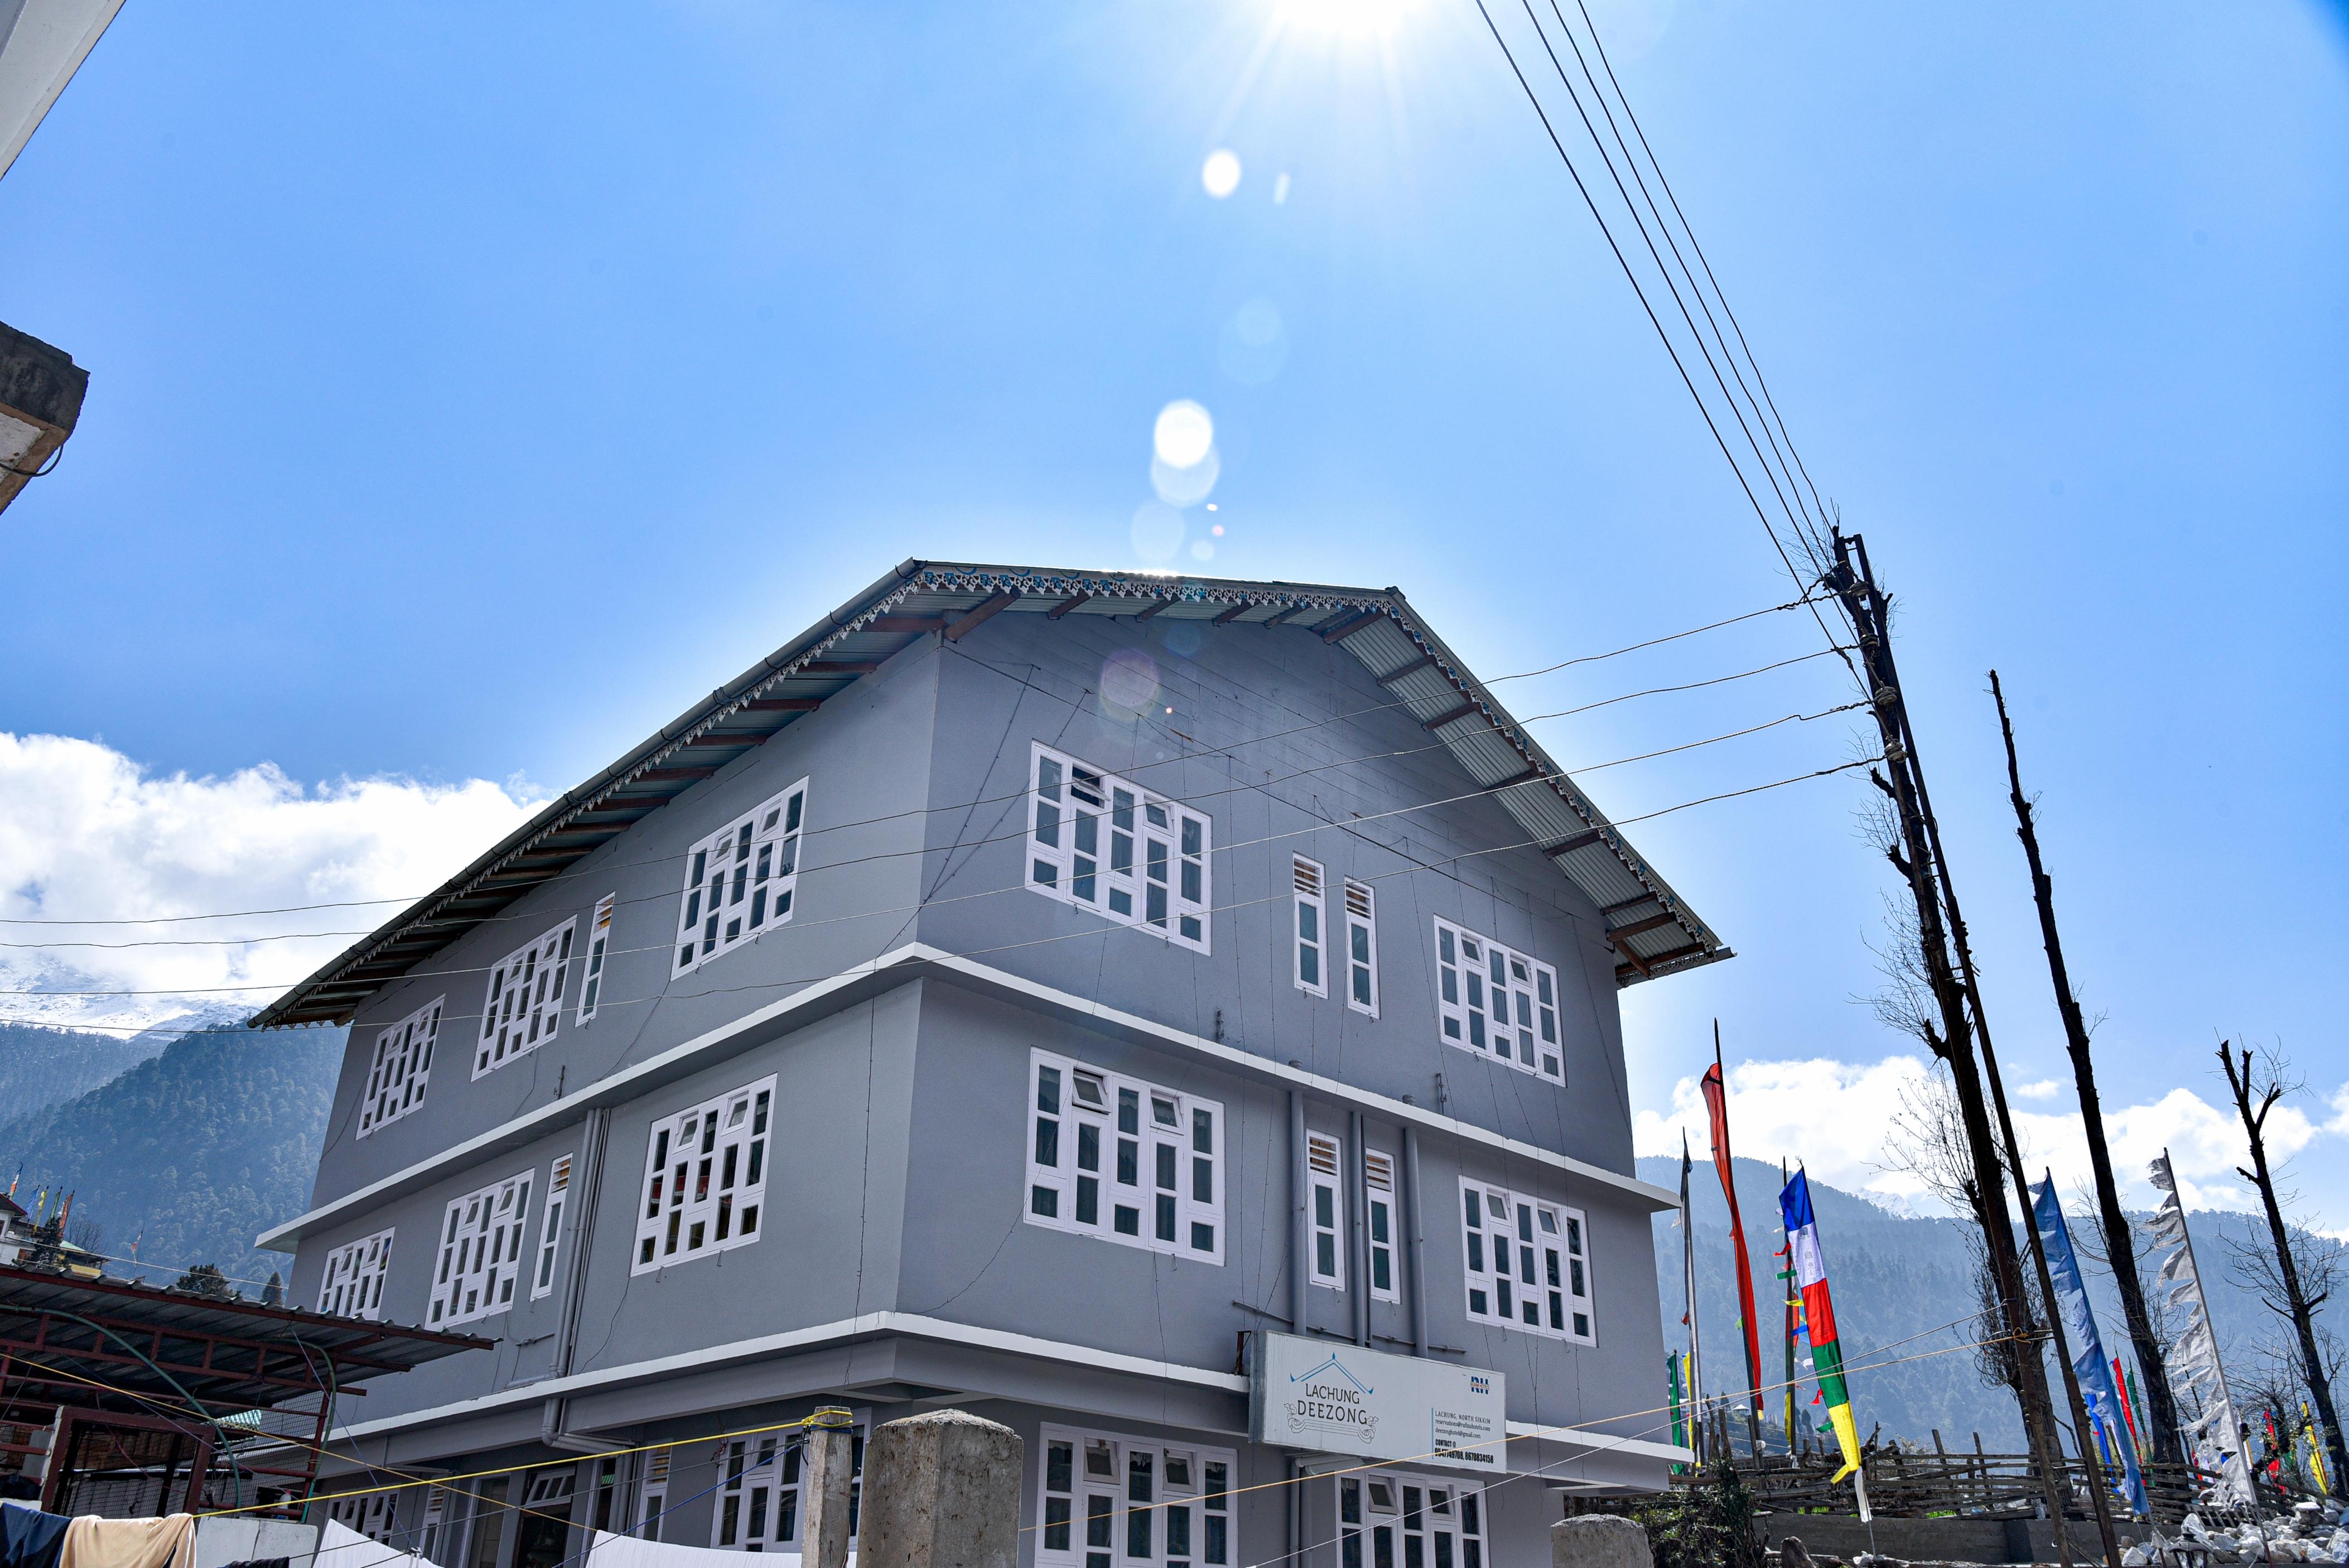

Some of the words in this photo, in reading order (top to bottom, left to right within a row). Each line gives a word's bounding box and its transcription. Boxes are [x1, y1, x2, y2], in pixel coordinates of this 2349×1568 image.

[1305, 1383, 1360, 1405] LACHUNG
[1298, 1400, 1367, 1425] DEEZONG
[1435, 1410, 1458, 1420] LACHUNG,
[1435, 1419, 1491, 1431] reservations@rufinahotels.com
[1435, 1427, 1481, 1439] deezonghotel@gmail.com
[1435, 1439, 1451, 1448] CONTACT
[1465, 1451, 1494, 1464] 8670834158
